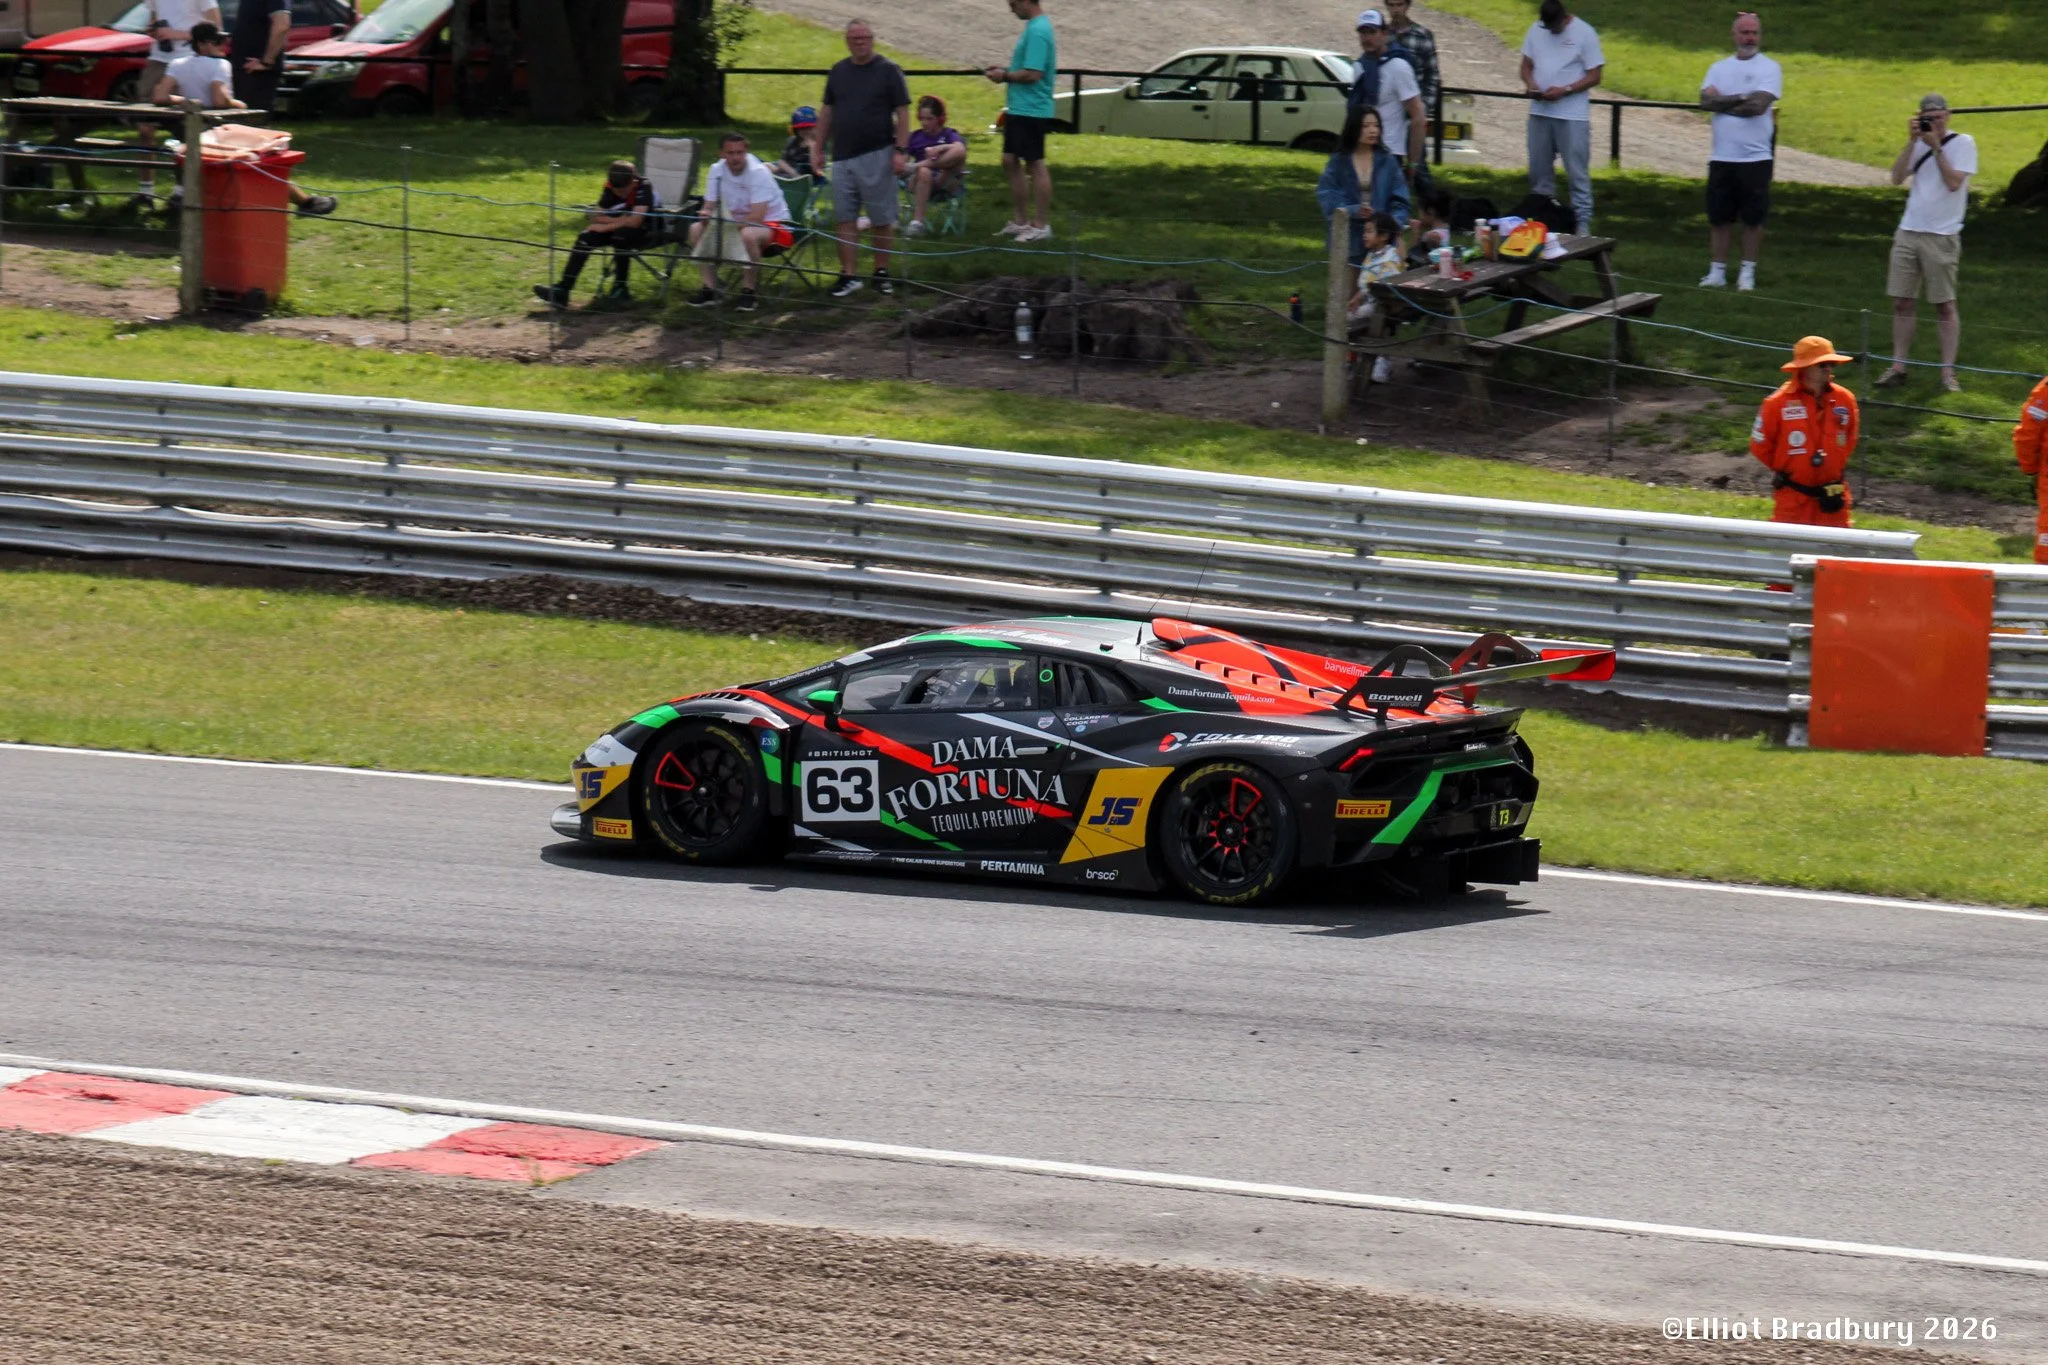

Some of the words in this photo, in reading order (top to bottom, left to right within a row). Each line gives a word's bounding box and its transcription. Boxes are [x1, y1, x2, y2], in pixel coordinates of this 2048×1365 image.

[1167, 686, 1276, 705] DamaFortunaTequila.com
[1368, 693, 1423, 702] Barwell
[1064, 714, 1101, 722] COLLARD
[761, 737, 777, 746] ESS
[1190, 732, 1301, 744] COLLARD
[932, 735, 1019, 766] DAMA
[806, 766, 875, 814] 63
[885, 768, 1069, 821] FORTUNA
[1337, 803, 1387, 815] PIRELLI
[595, 821, 628, 835] PIRELLI
[931, 811, 981, 833] TEQUILA
[980, 859, 1046, 876] PERTAMINA
[1085, 868, 1117, 881] brscc
